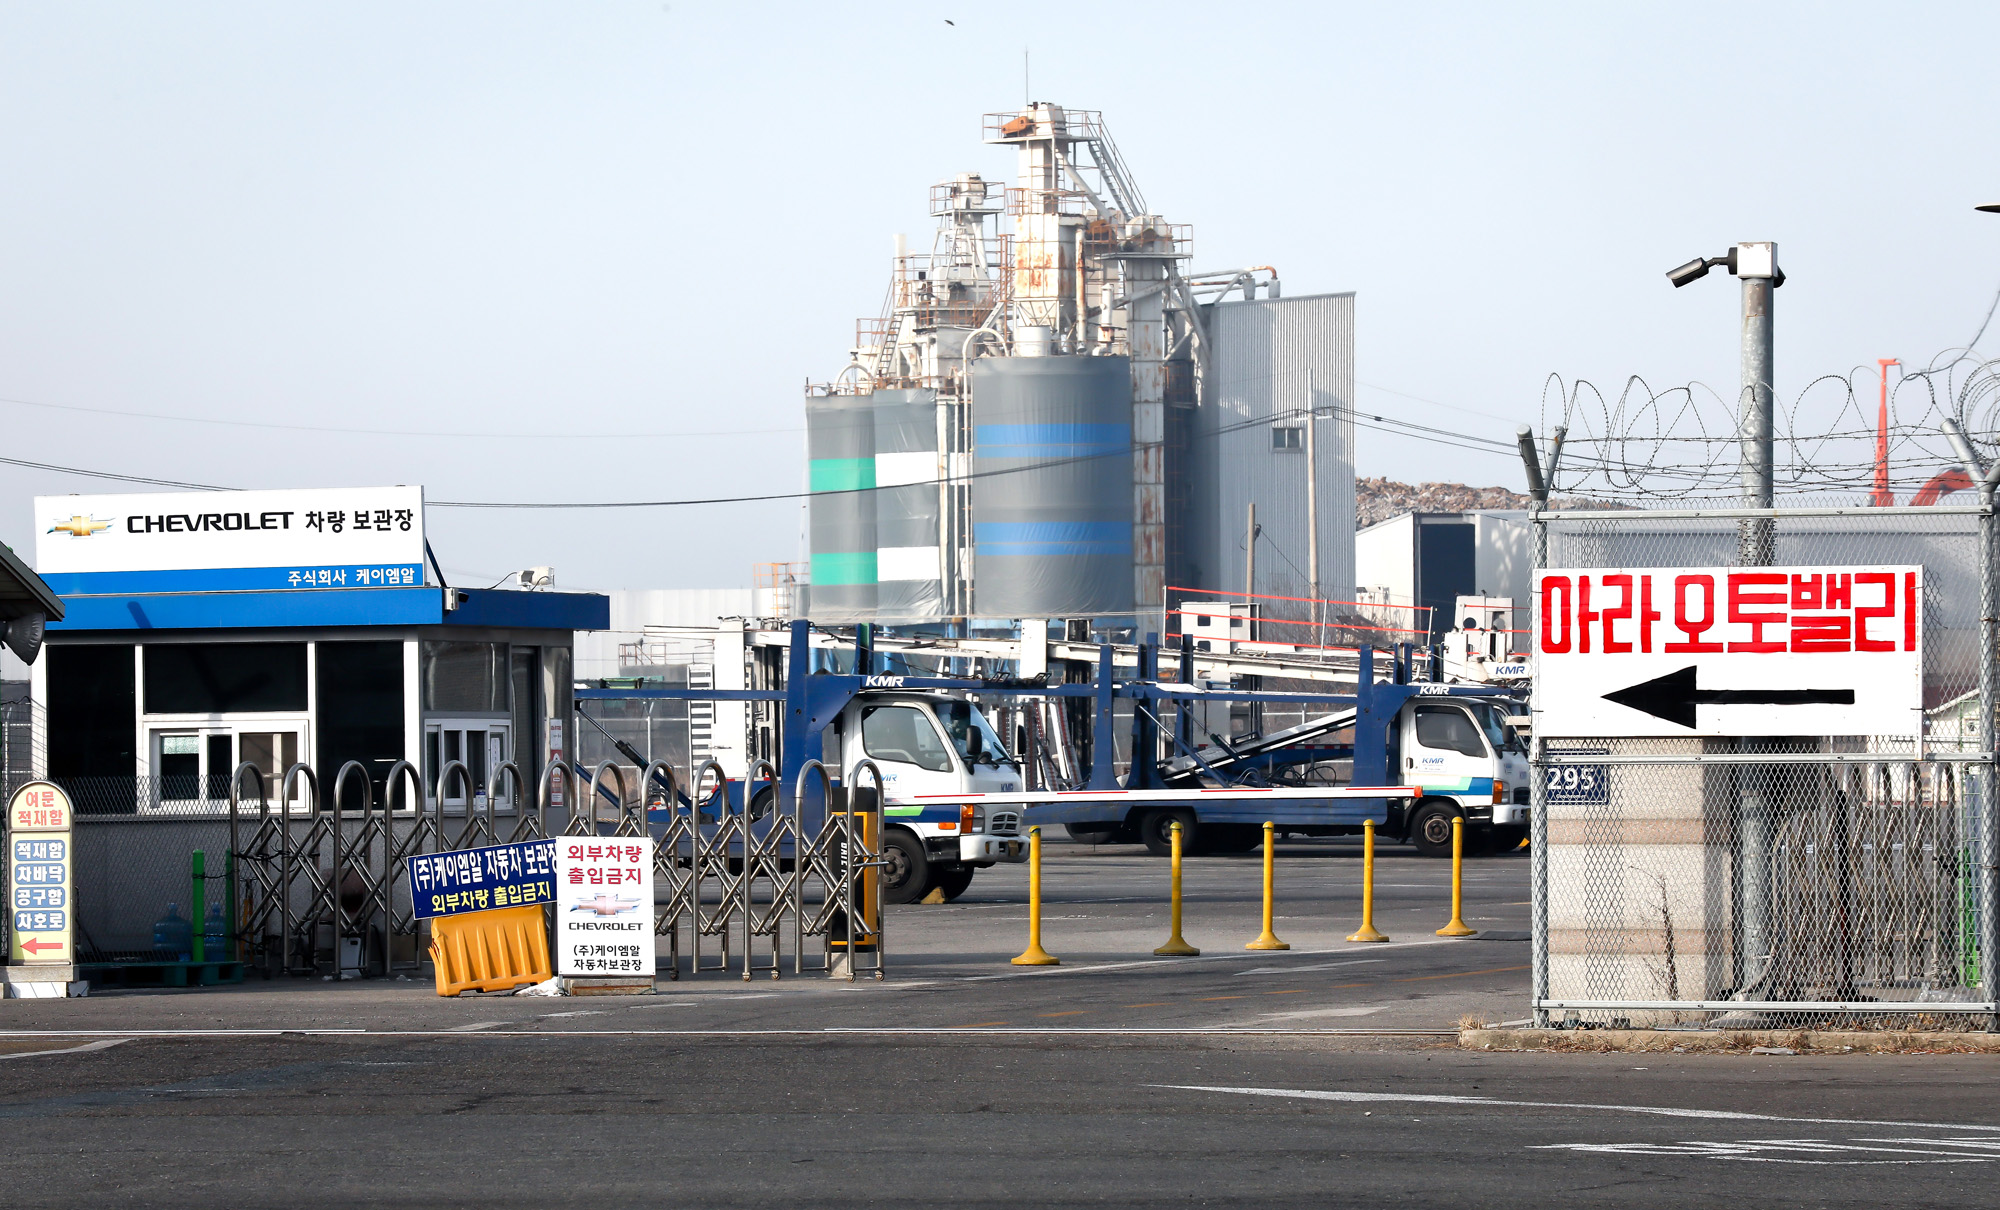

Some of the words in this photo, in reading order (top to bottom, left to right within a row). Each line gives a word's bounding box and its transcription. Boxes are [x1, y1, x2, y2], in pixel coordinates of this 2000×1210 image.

[126, 510, 295, 534] CHEVROLET
[305, 510, 346, 533] 차량
[352, 508, 414, 532] 보관장
[287, 569, 347, 586] 주식회사
[355, 567, 415, 584] 케이엠알
[1541, 572, 1916, 654] 아라오토밸리
[1495, 665, 1526, 675] KMR
[865, 675, 905, 688] KMR
[1420, 686, 1450, 695] KMR
[1421, 757, 1445, 765] KMR
[1547, 767, 1595, 790] 295
[25, 791, 55, 808] 여문
[17, 809, 64, 827] 적재함
[17, 842, 64, 859] 적재함
[567, 845, 642, 863] 외부차량
[17, 865, 63, 883] 차바닥
[413, 851, 483, 893] (주)케이엠알
[485, 847, 522, 881] 자동차
[567, 867, 642, 885] 출입금지
[17, 889, 63, 906] 공구함
[431, 888, 489, 913] 외부차량
[494, 881, 551, 906] 출입금지
[17, 912, 63, 930] 차호로
[568, 922, 644, 931] CHEVROLET
[573, 945, 640, 957] (주)케이엠알
[573, 958, 642, 971] 자동차보관장
